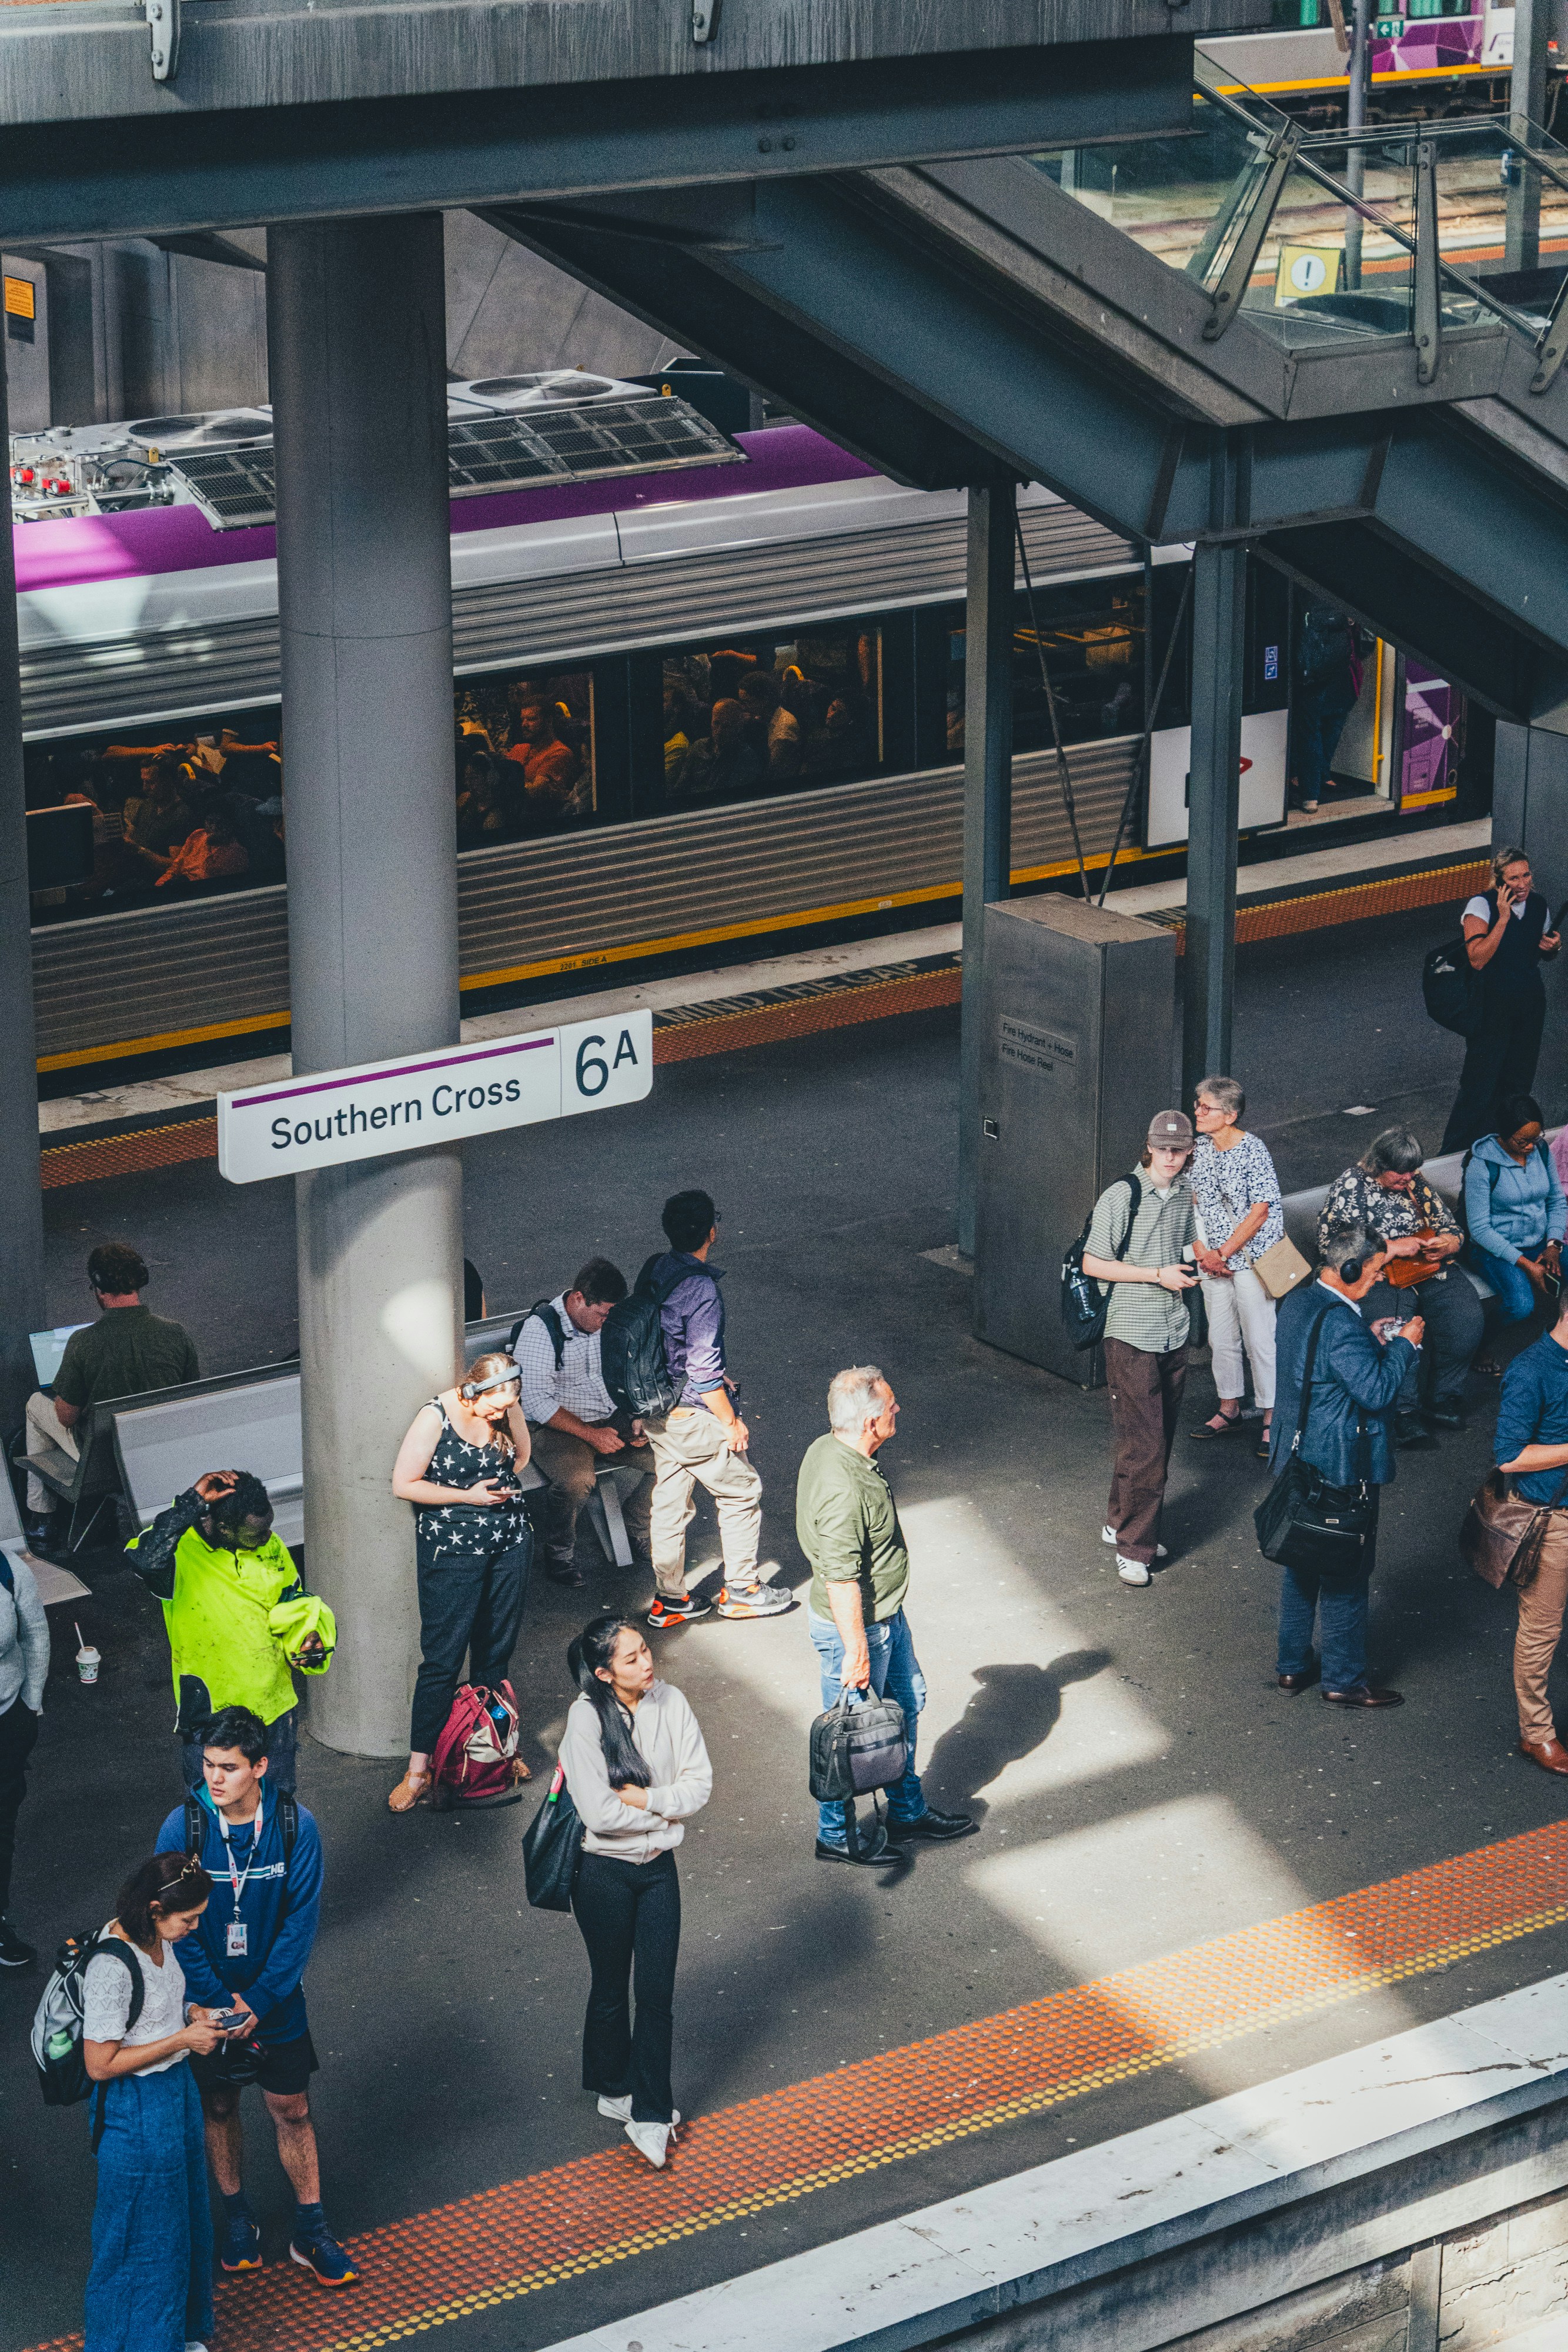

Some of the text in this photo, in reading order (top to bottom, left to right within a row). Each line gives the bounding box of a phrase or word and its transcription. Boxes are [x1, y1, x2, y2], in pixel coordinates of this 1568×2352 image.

[581, 957, 599, 966] SIDE
[653, 961, 918, 1022] MIND THE GAP
[576, 1030, 638, 1097] 6A
[1002, 1023, 1016, 1036] Fire
[1017, 1028, 1046, 1048] Hydrant
[1054, 1043, 1074, 1058] Hose
[1002, 1043, 1054, 1071] Fire Hose Reel
[272, 1080, 520, 1150] Southern Cross
